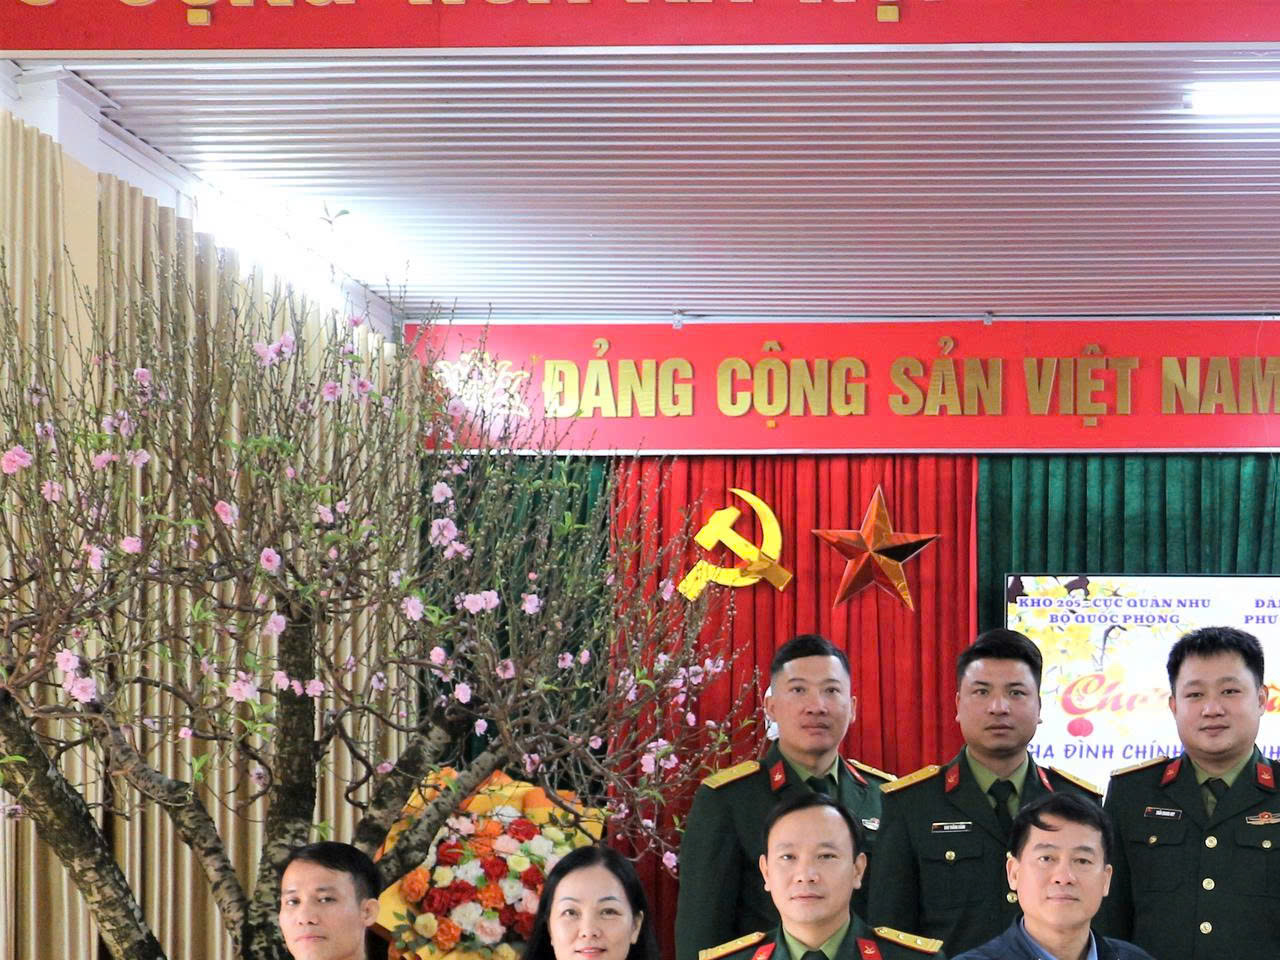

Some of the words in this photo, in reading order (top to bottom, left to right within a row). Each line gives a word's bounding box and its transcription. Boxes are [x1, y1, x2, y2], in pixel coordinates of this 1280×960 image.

[542, 338, 694, 418] ĐẢNG
[717, 340, 867, 428] CỘNG
[888, 336, 1003, 416] SẢN
[1024, 343, 1139, 427] VIỆT
[1019, 598, 1053, 608] KHO
[1177, 599, 1211, 608] NHU
[1064, 739, 1115, 759] ĐÌNH
[1122, 739, 1185, 760] CHÍNH
